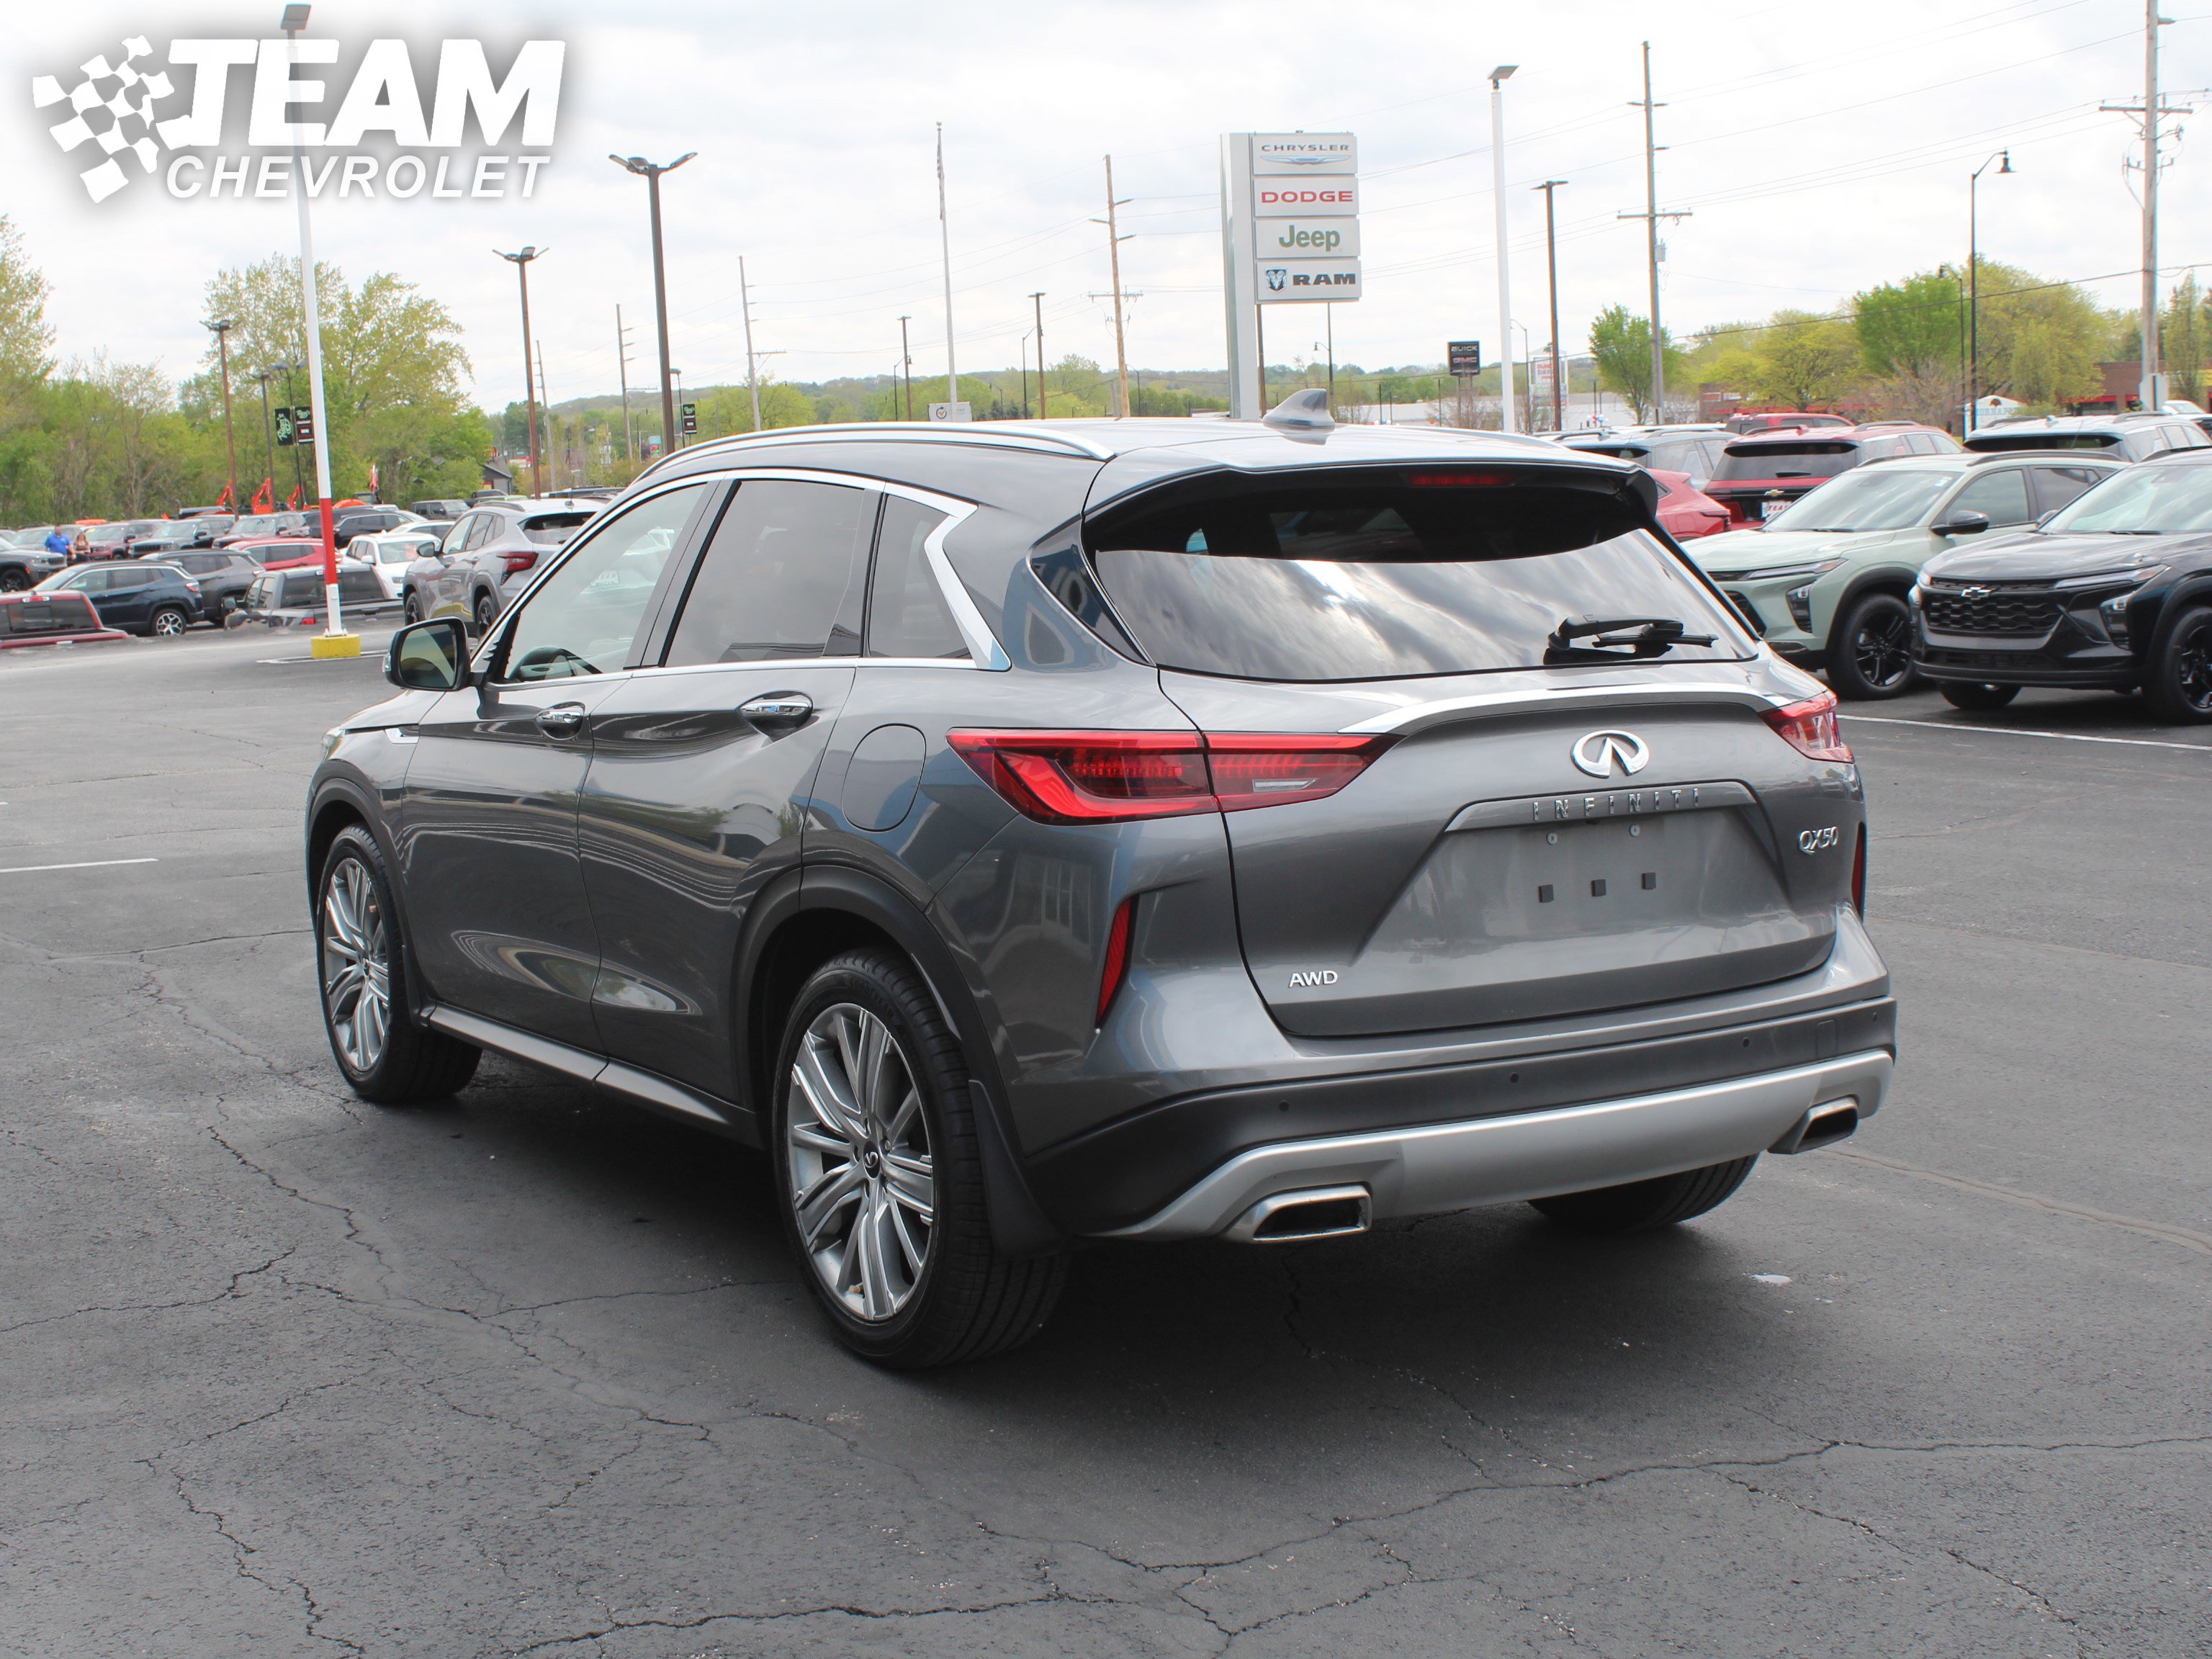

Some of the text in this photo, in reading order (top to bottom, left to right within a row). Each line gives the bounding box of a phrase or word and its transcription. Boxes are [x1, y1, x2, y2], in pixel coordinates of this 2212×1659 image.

[1262, 191, 1353, 203] DODGE
[1279, 225, 1341, 252] Jeep
[1292, 274, 1356, 285] RAM
[1532, 788, 1699, 822] INFINITI
[1799, 826, 1839, 855] QX50
[1288, 970, 1338, 988] AWD
